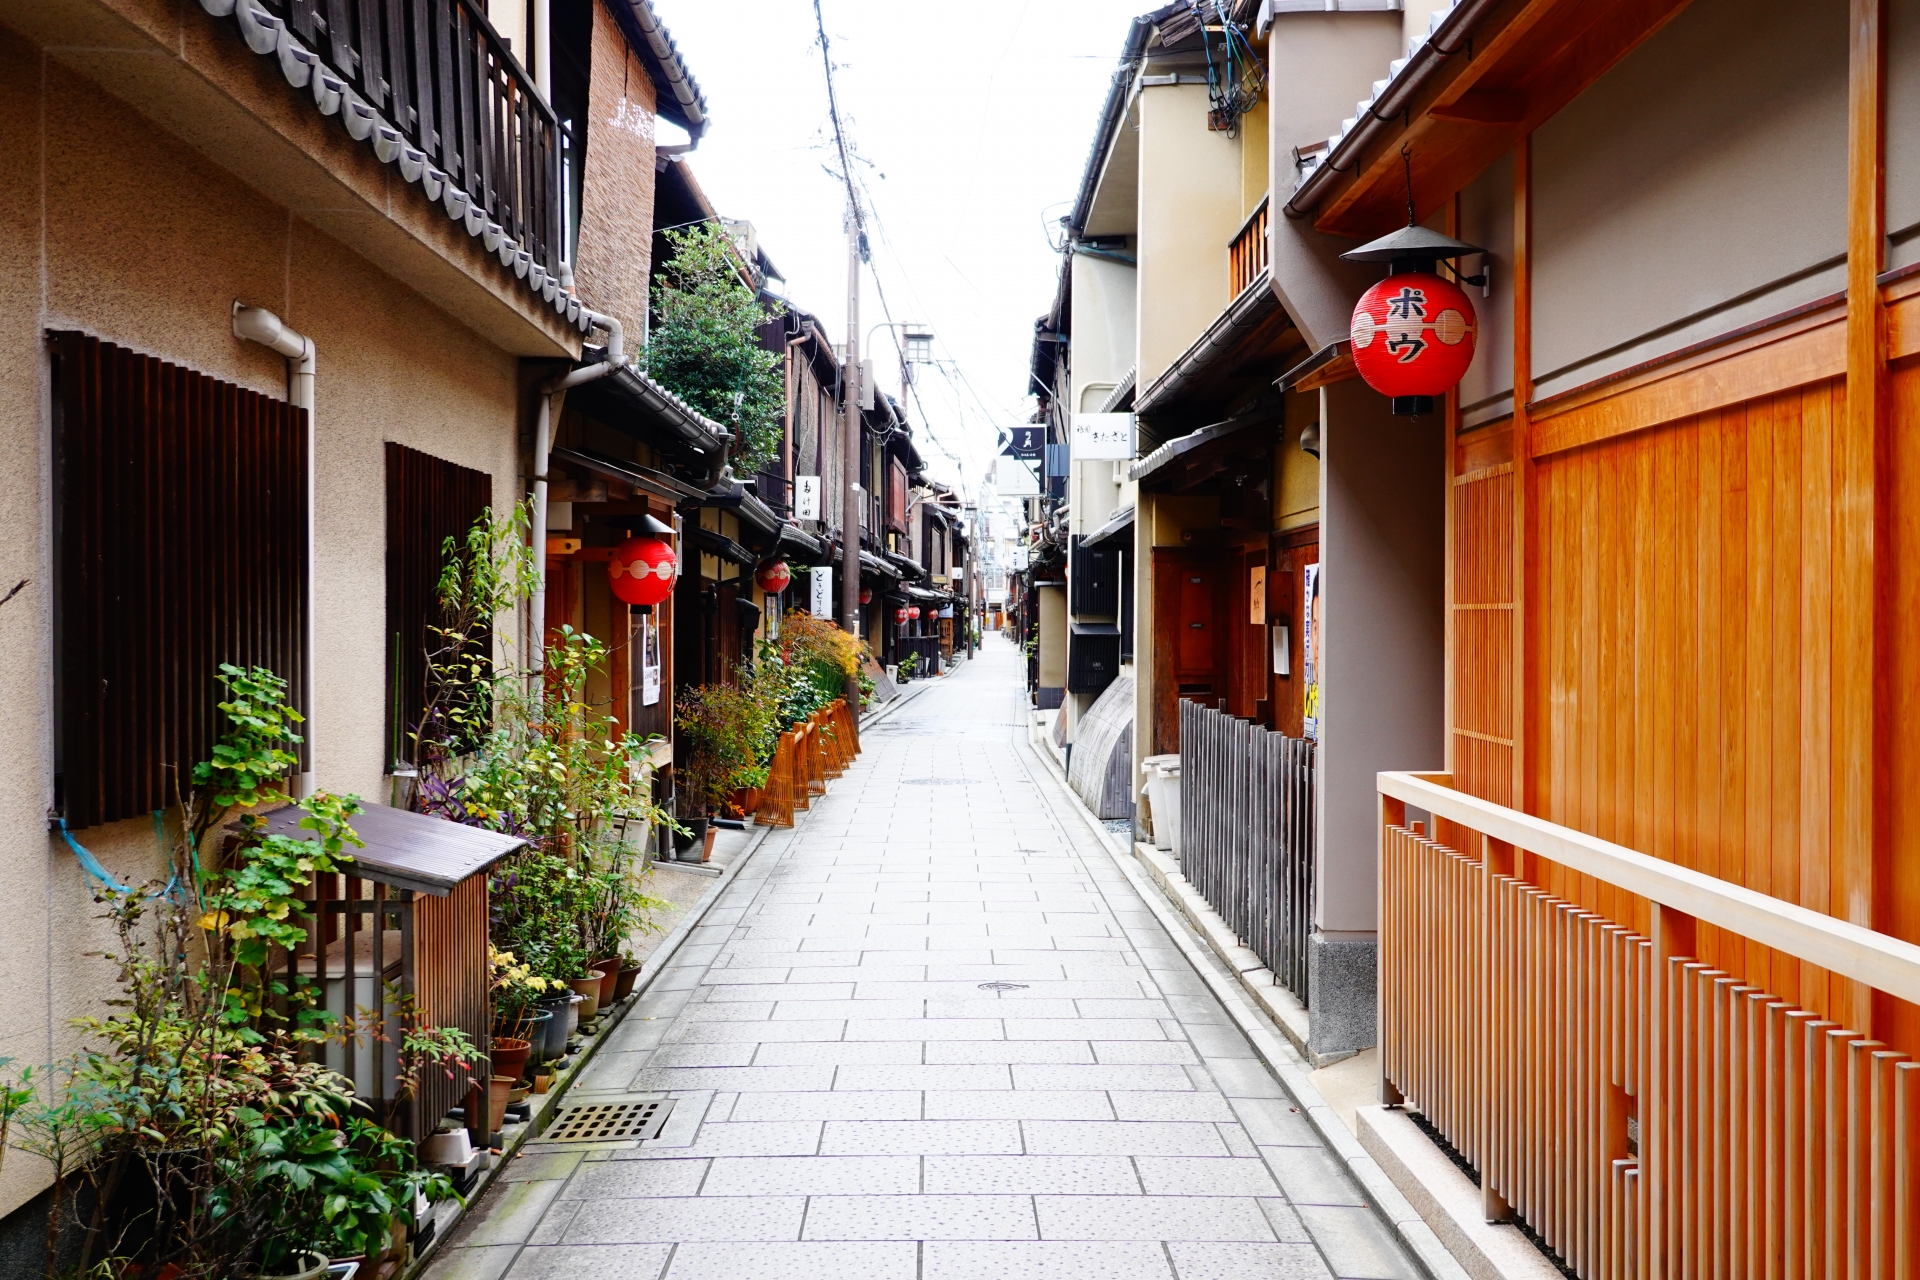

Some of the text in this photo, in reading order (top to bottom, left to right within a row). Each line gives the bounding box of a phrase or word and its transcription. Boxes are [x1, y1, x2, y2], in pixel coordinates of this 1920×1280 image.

[1388, 288, 1426, 362] ポウ
[815, 569, 825, 617] どうどすえ
